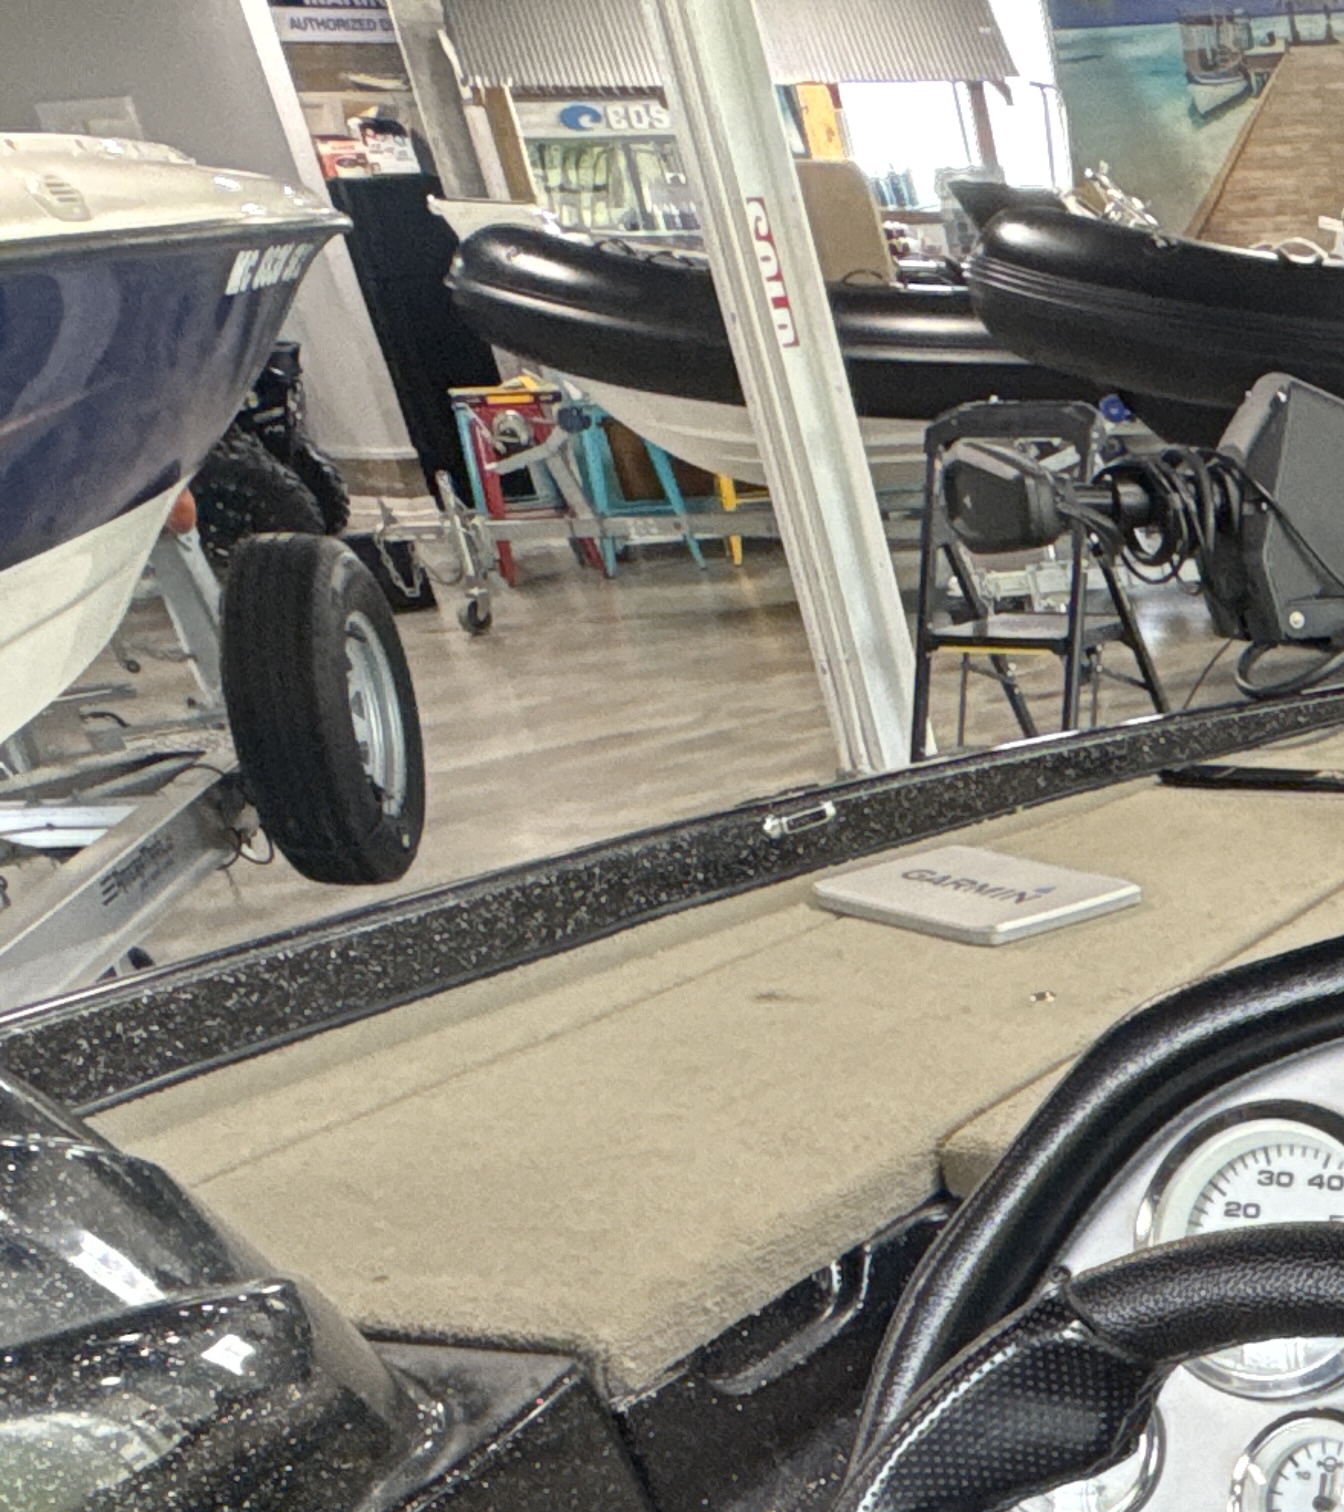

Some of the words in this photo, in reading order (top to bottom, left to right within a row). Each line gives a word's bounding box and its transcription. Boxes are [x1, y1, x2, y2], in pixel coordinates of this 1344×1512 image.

[289, 16, 377, 31] AUTHORIZED
[902, 869, 1042, 904] GARMIN
[1257, 1169, 1294, 1188] 30
[1307, 1173, 1344, 1191] 40
[1223, 1201, 1261, 1219] 20
